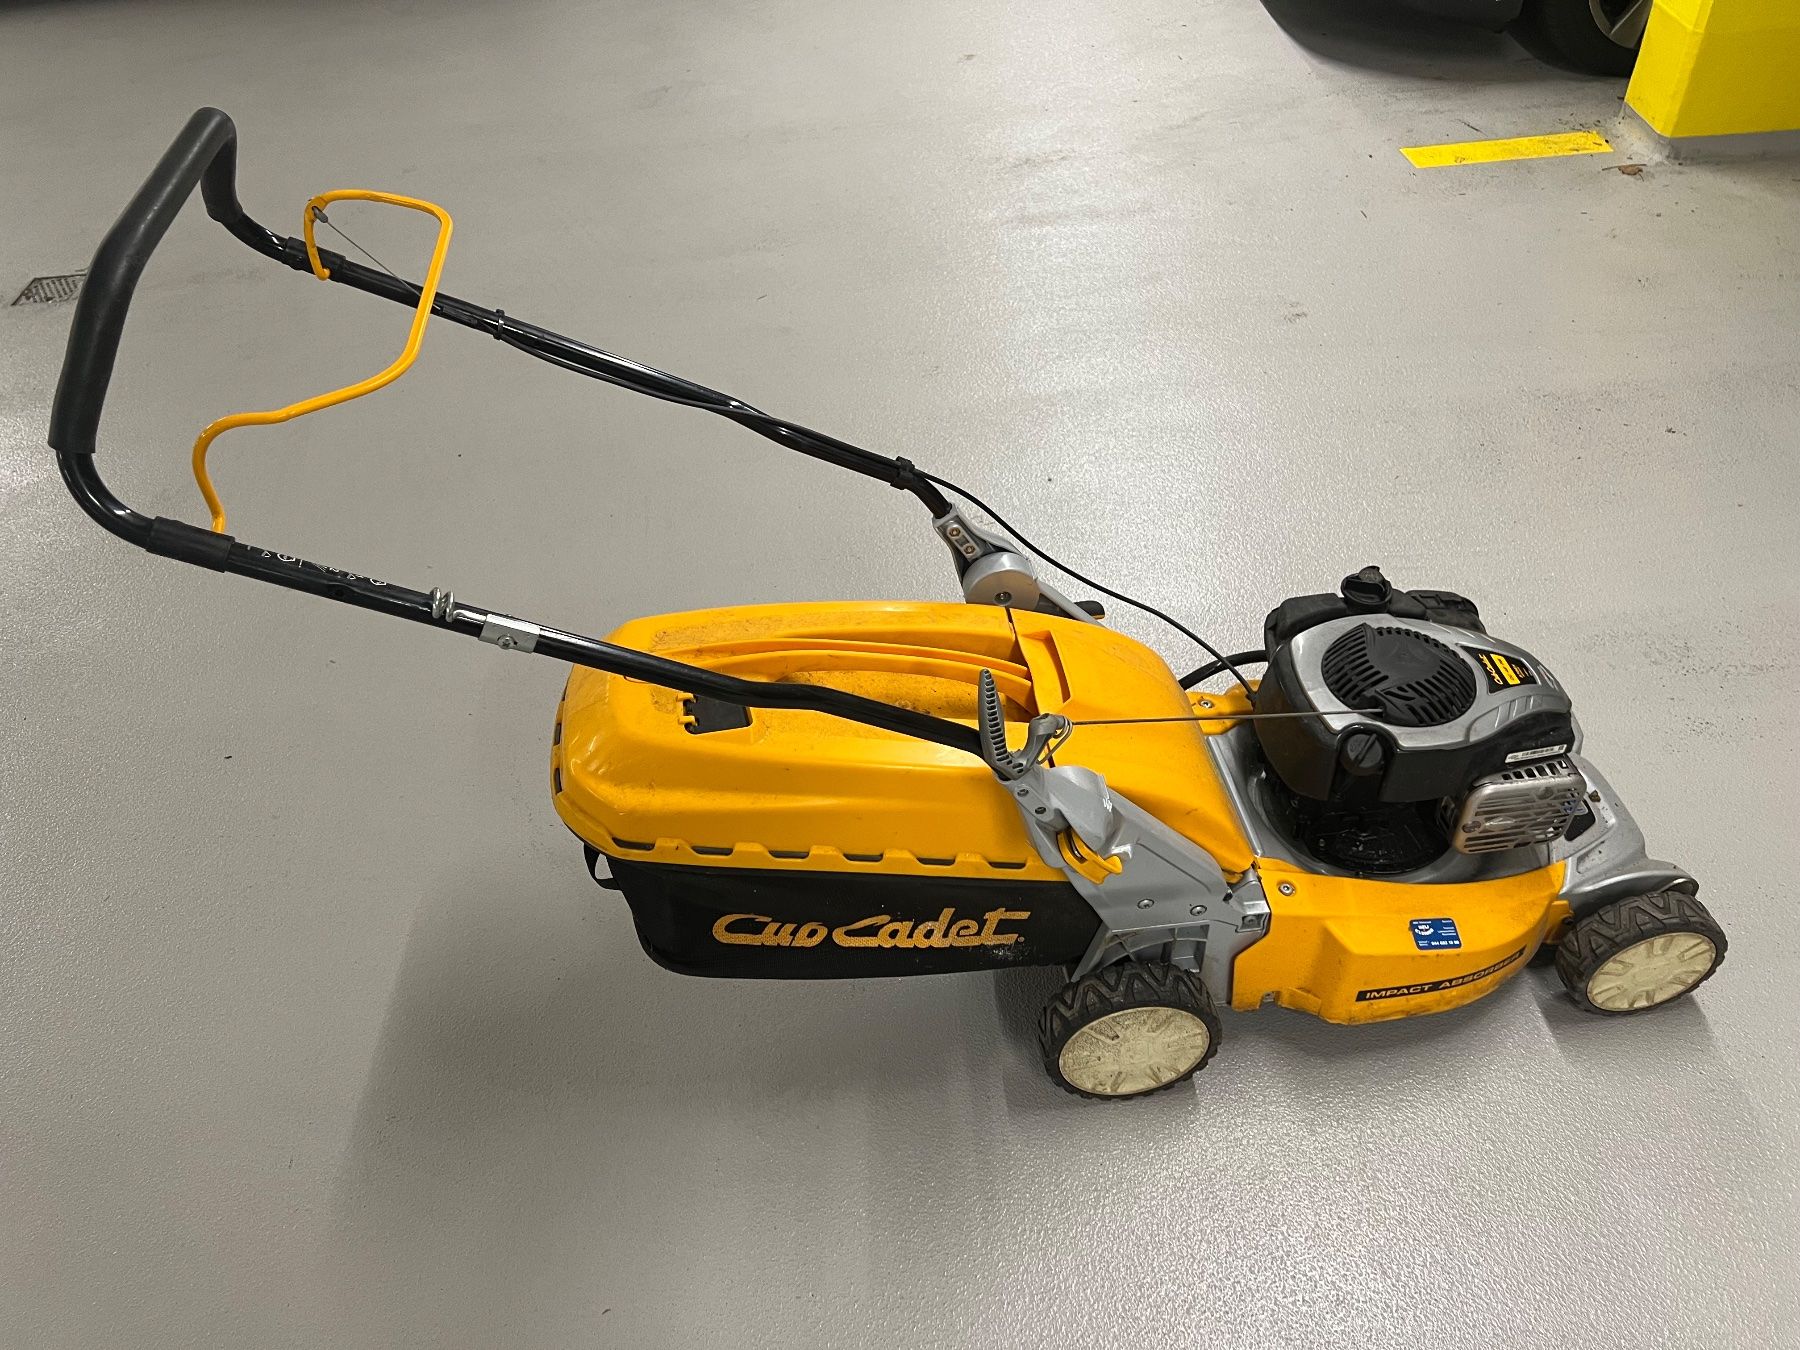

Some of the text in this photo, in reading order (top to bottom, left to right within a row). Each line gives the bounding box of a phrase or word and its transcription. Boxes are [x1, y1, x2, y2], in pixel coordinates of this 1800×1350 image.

[832, 907, 1031, 948] Cadet
[1365, 951, 1522, 999] IMPACT ABSORBER
